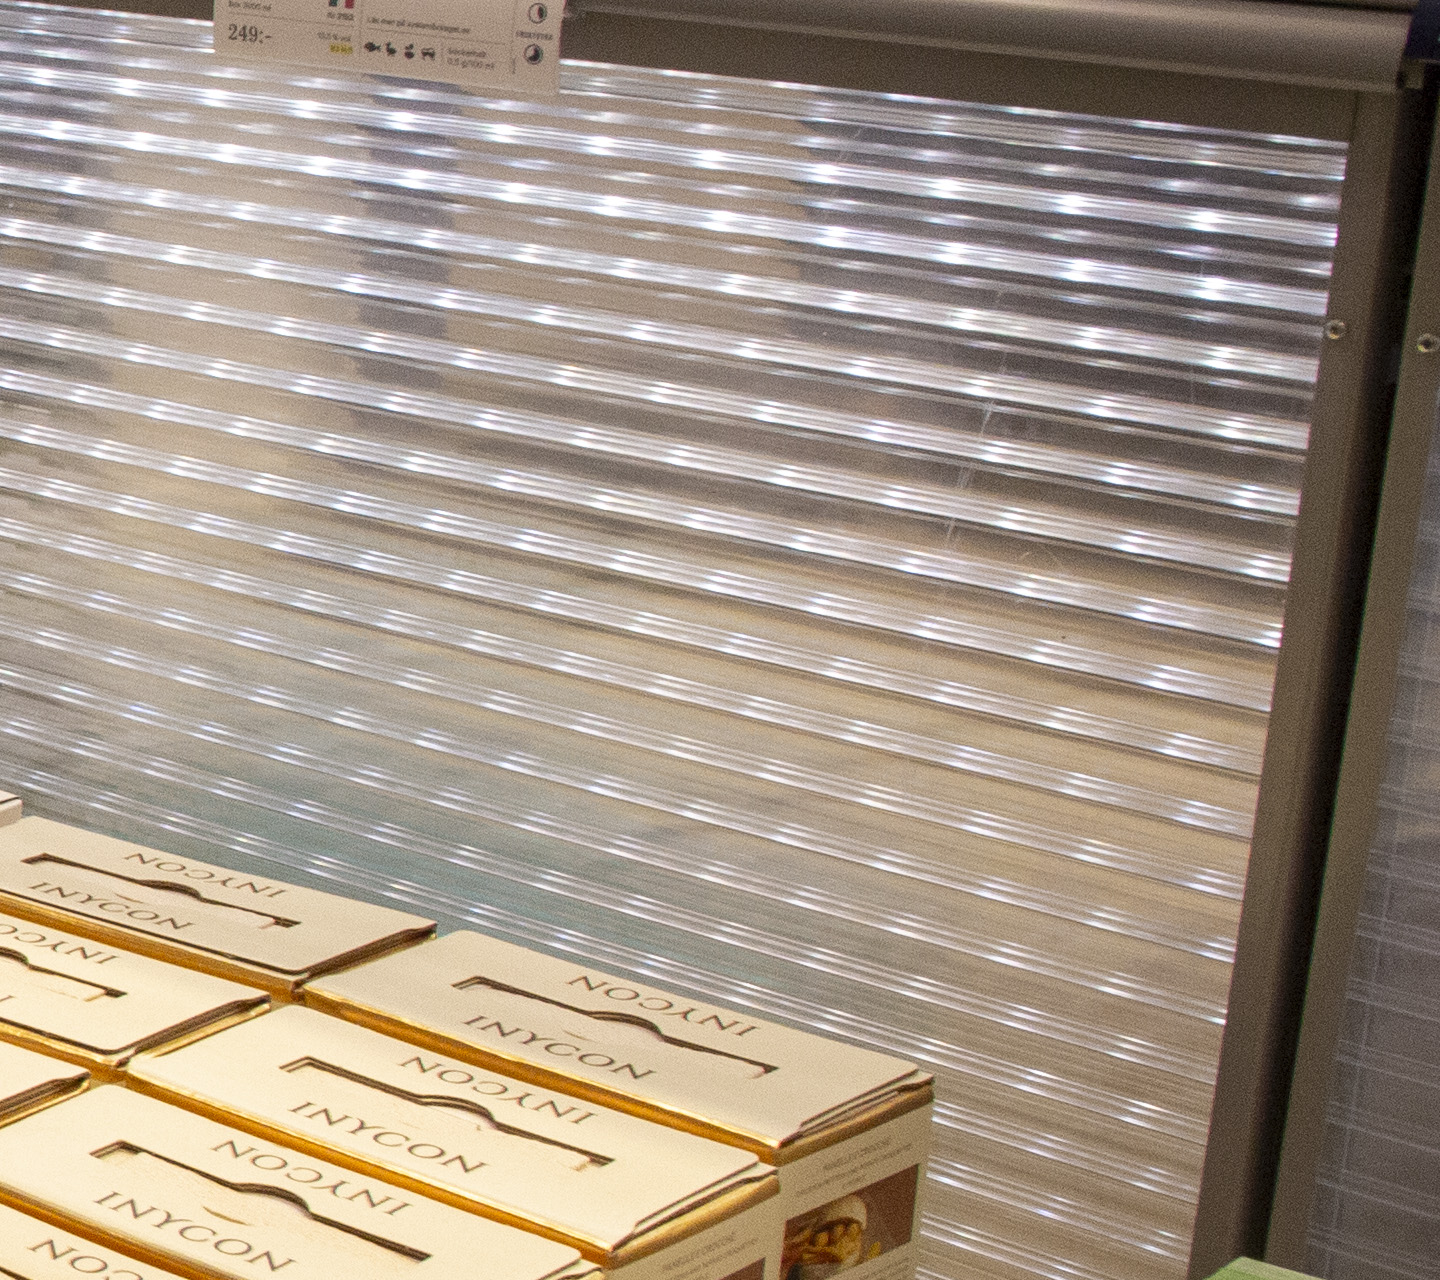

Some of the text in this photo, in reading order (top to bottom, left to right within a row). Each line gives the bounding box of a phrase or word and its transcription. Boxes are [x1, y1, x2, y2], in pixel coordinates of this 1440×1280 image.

[228, 23, 273, 44] 249:-
[28, 882, 198, 931] INYCON
[122, 851, 289, 900] INYCON
[567, 973, 762, 1038] INYCON
[462, 1014, 658, 1082] INYCON
[398, 1054, 599, 1126] INYCON
[285, 1101, 490, 1174] INYCON
[211, 1137, 414, 1216] INYCON
[92, 1190, 298, 1273] INYCON
